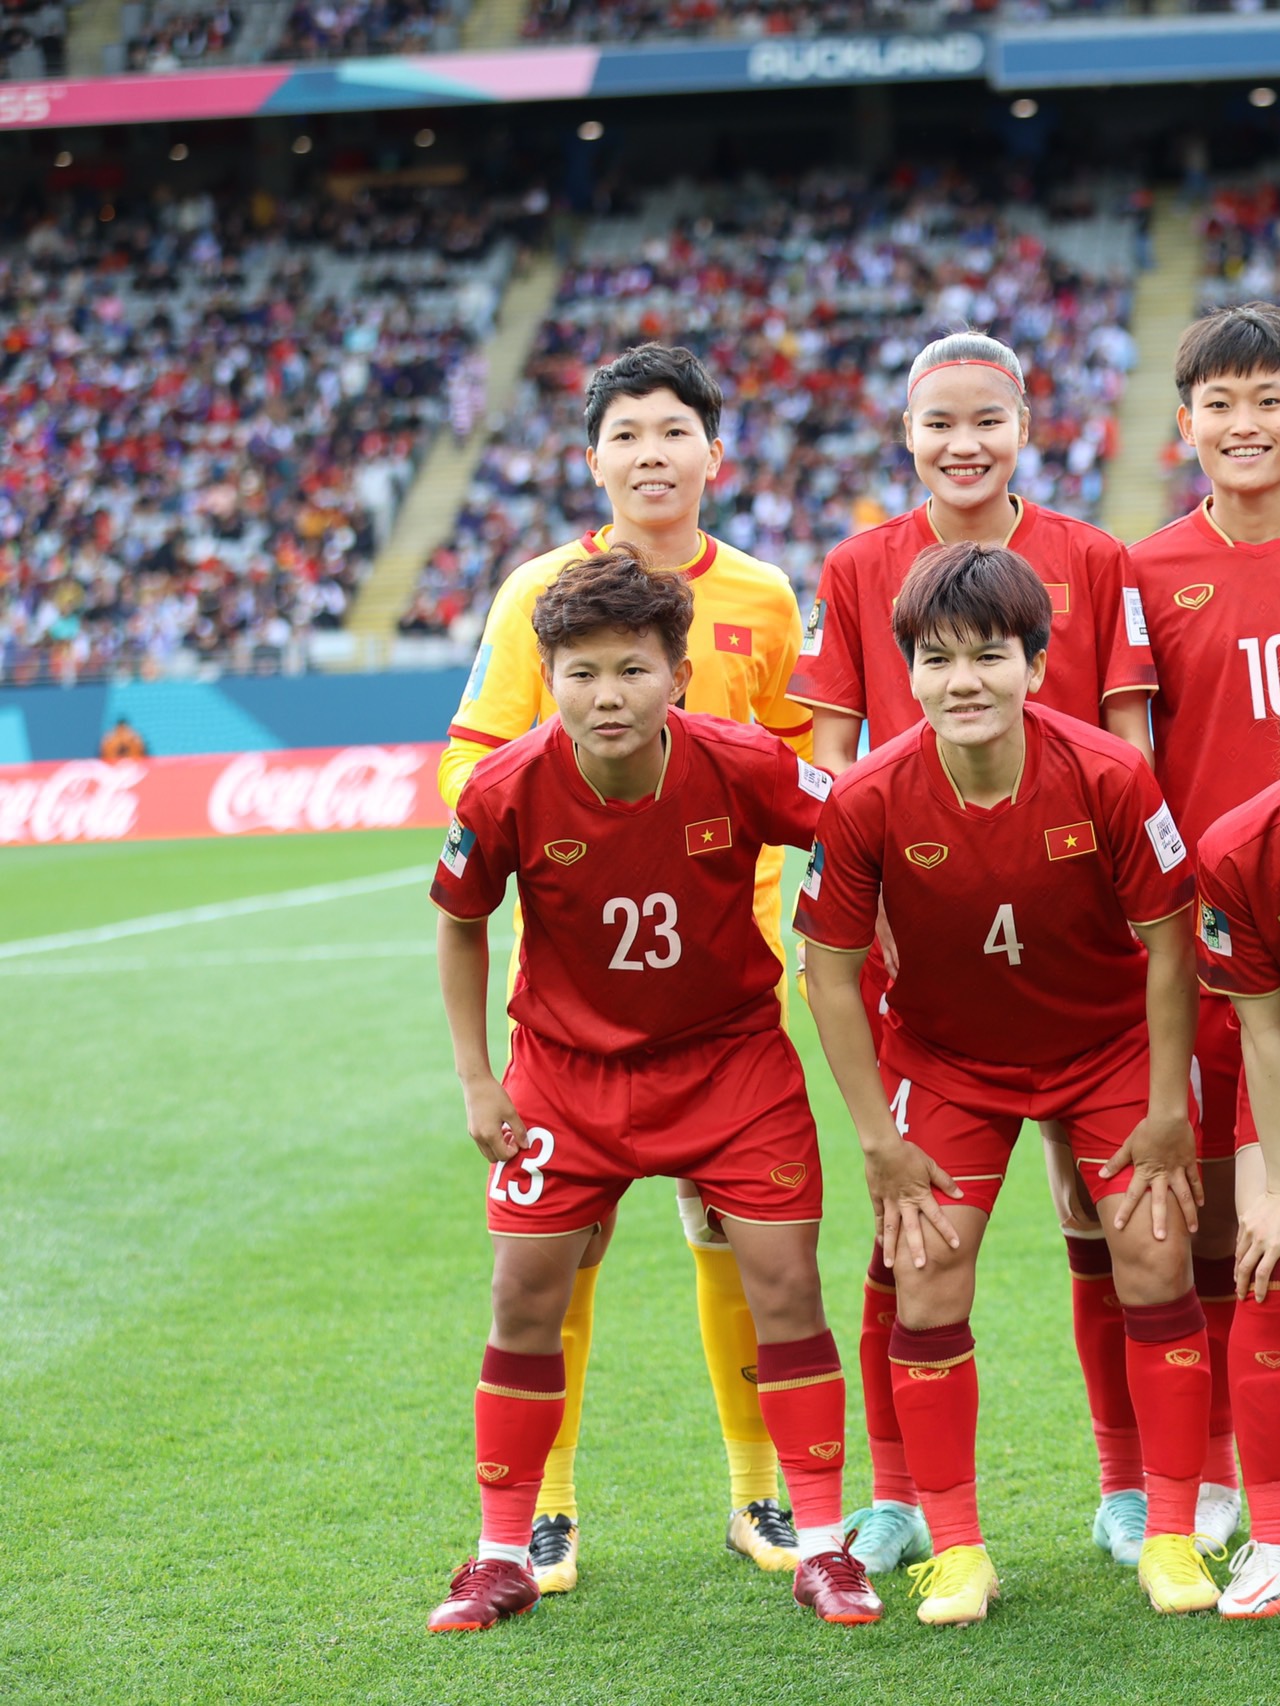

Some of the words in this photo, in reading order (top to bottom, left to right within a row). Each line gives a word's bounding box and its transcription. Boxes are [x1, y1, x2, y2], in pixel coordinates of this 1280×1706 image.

[748, 36, 983, 80] AUCKLAND
[207, 744, 428, 834] Coca-Cola
[603, 892, 682, 971] 23
[983, 904, 1024, 966] 4
